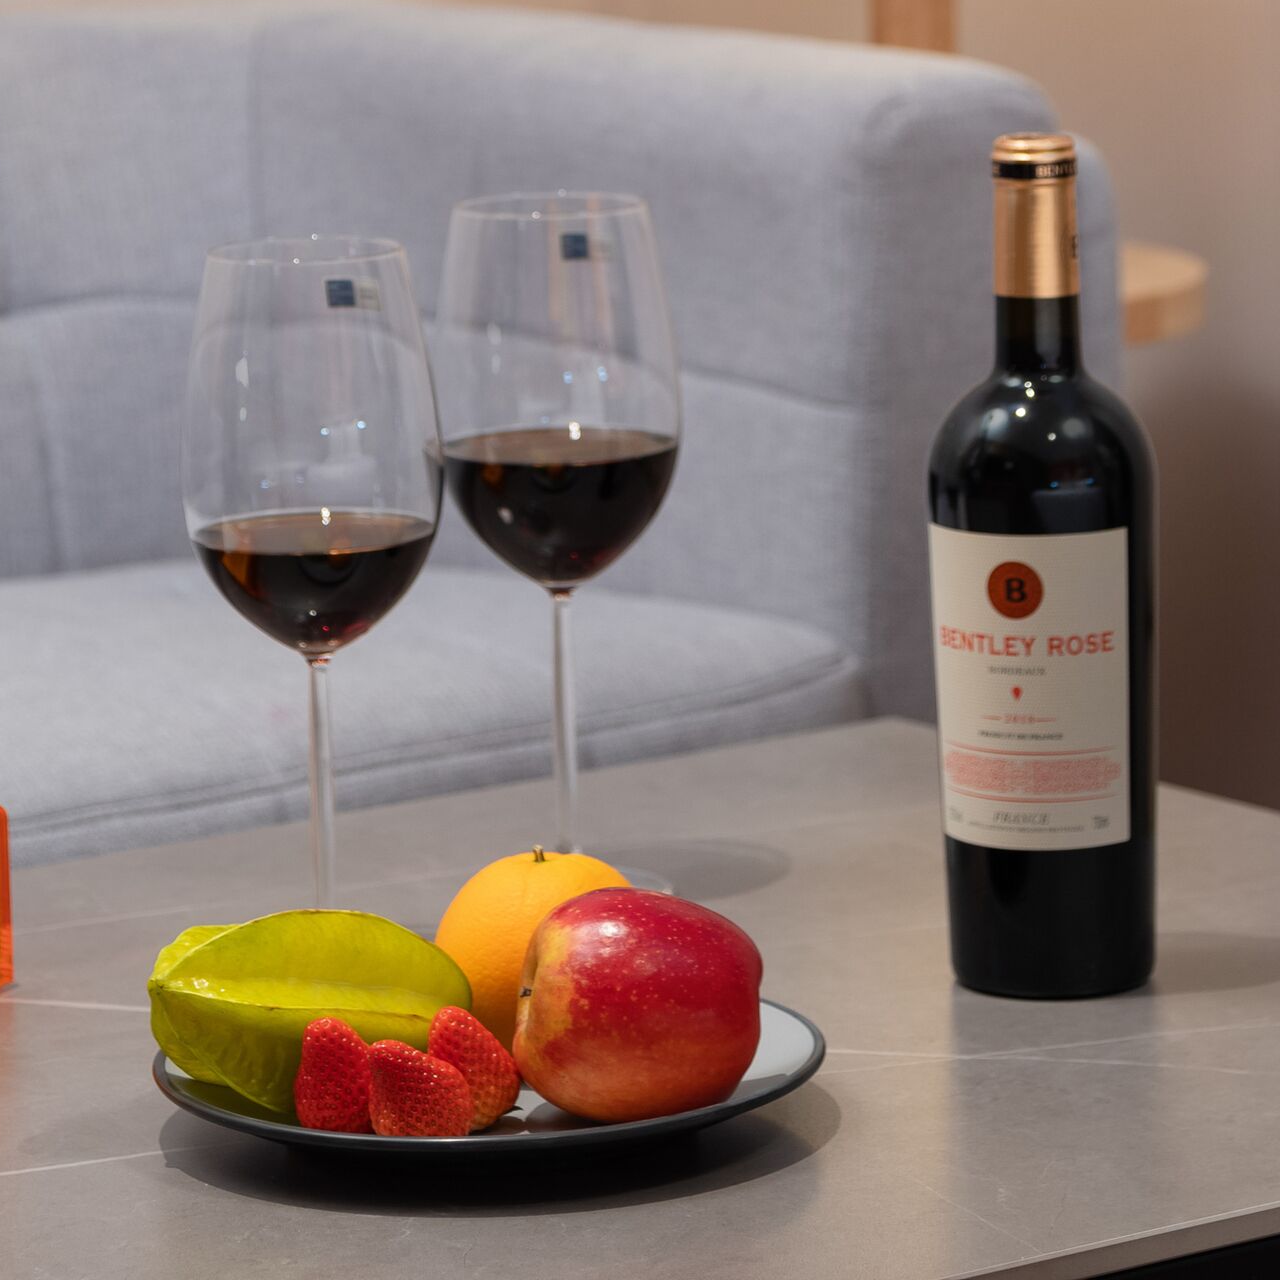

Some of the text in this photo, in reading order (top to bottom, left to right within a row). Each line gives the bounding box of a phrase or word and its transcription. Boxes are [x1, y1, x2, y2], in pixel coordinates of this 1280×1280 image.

[1005, 578, 1027, 603] B
[941, 626, 1115, 656] BENTLEY ROSE
